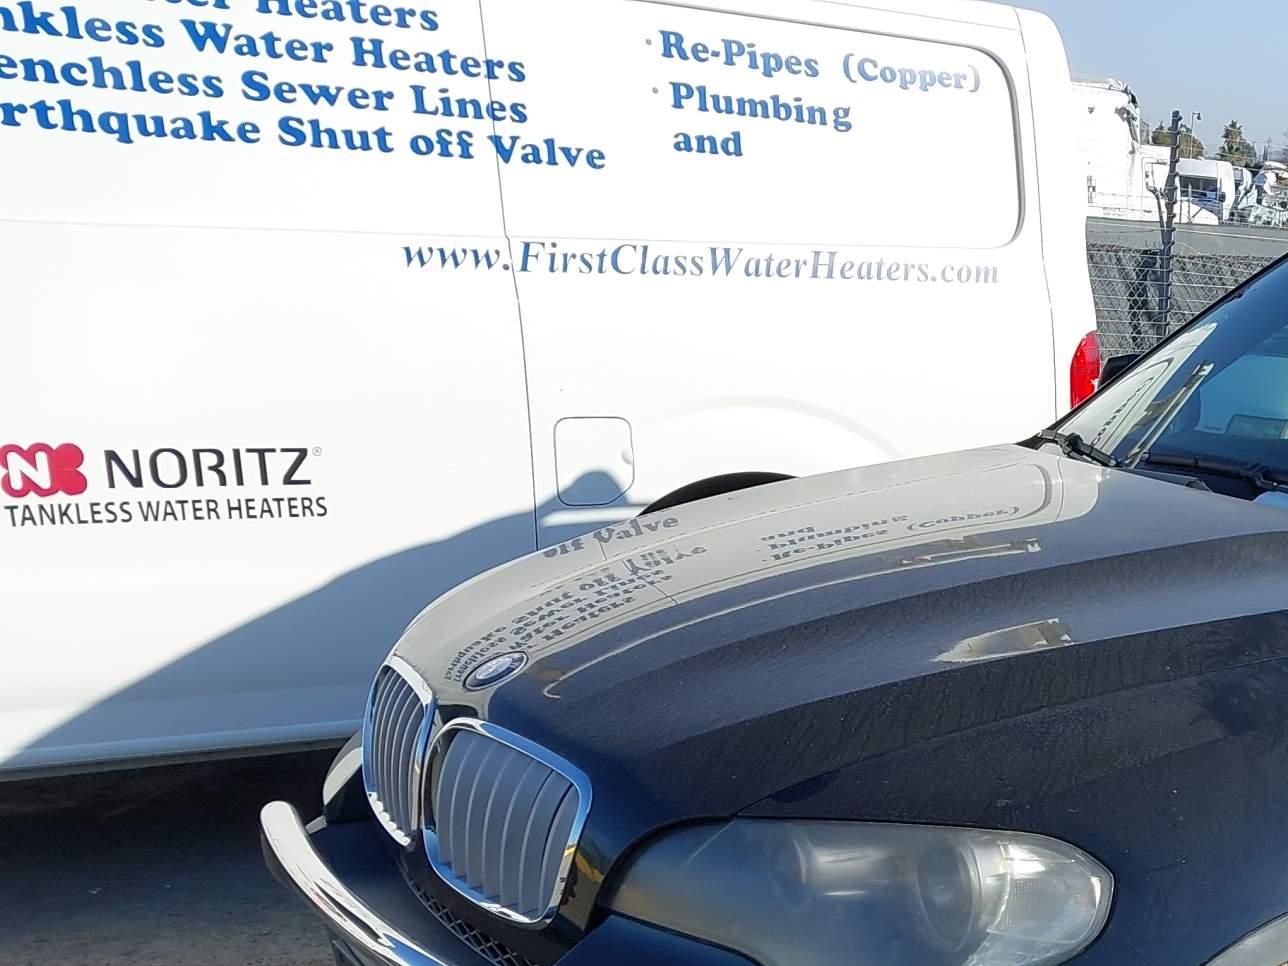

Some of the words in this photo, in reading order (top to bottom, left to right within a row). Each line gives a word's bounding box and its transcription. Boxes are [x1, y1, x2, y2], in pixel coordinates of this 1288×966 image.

[179, 19, 334, 63] Water
[350, 36, 526, 83] Heaters
[659, 30, 819, 78] Re-Pipes
[843, 53, 981, 93] (Copper)
[0, 54, 225, 99] enchless
[241, 70, 395, 112] Sewer
[409, 85, 529, 124] Lines
[669, 81, 852, 132] Plumbing
[0, 99, 261, 145] rthquake
[278, 116, 395, 154] Shut
[409, 128, 475, 160] off
[486, 134, 606, 170] Valve
[673, 131, 743, 157] and
[402, 240, 999, 284] www.FirstClassWaterHeaters.com
[104, 448, 312, 488] NORITZ
[4, 501, 132, 527] TANKLESS
[138, 499, 220, 522] WATER
[227, 497, 328, 519] HEATERS
[592, 517, 678, 543] Valve
